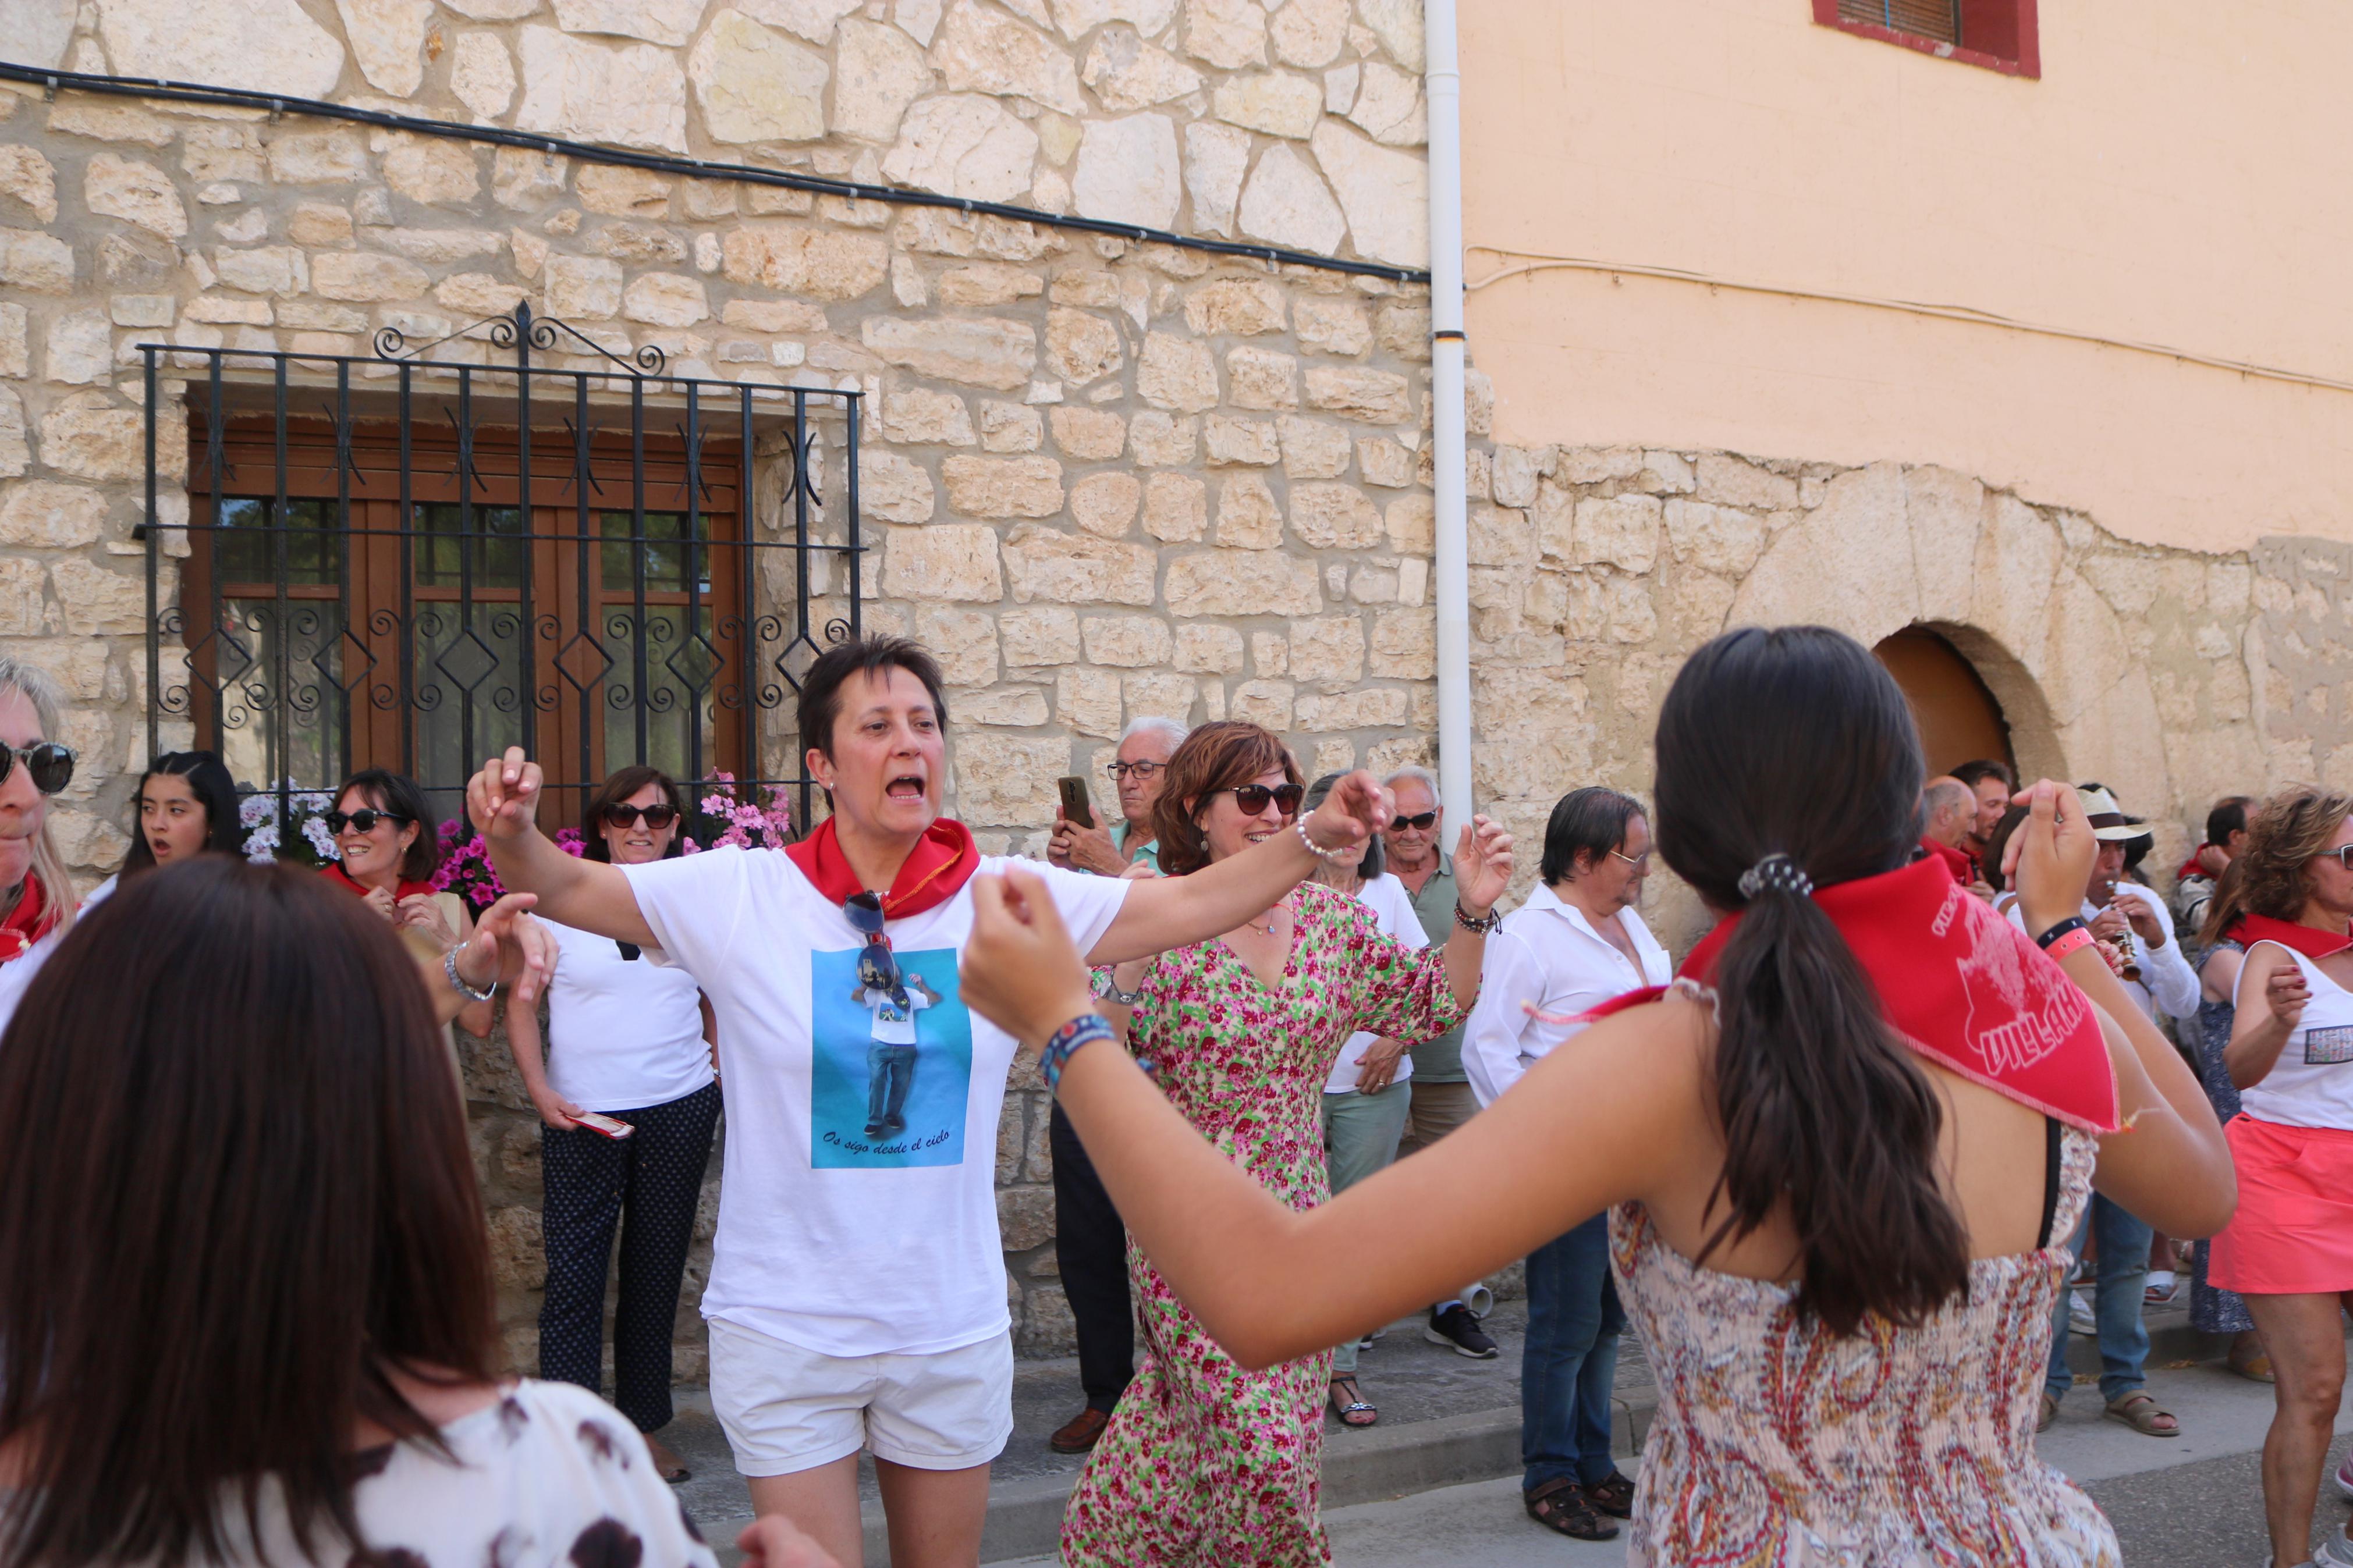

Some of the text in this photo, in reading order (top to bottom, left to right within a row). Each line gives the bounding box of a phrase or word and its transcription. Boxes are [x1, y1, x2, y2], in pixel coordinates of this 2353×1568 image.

[1979, 979, 2085, 1075] VILLAH
[823, 1129, 950, 1155] Os sigo desde el cielo
